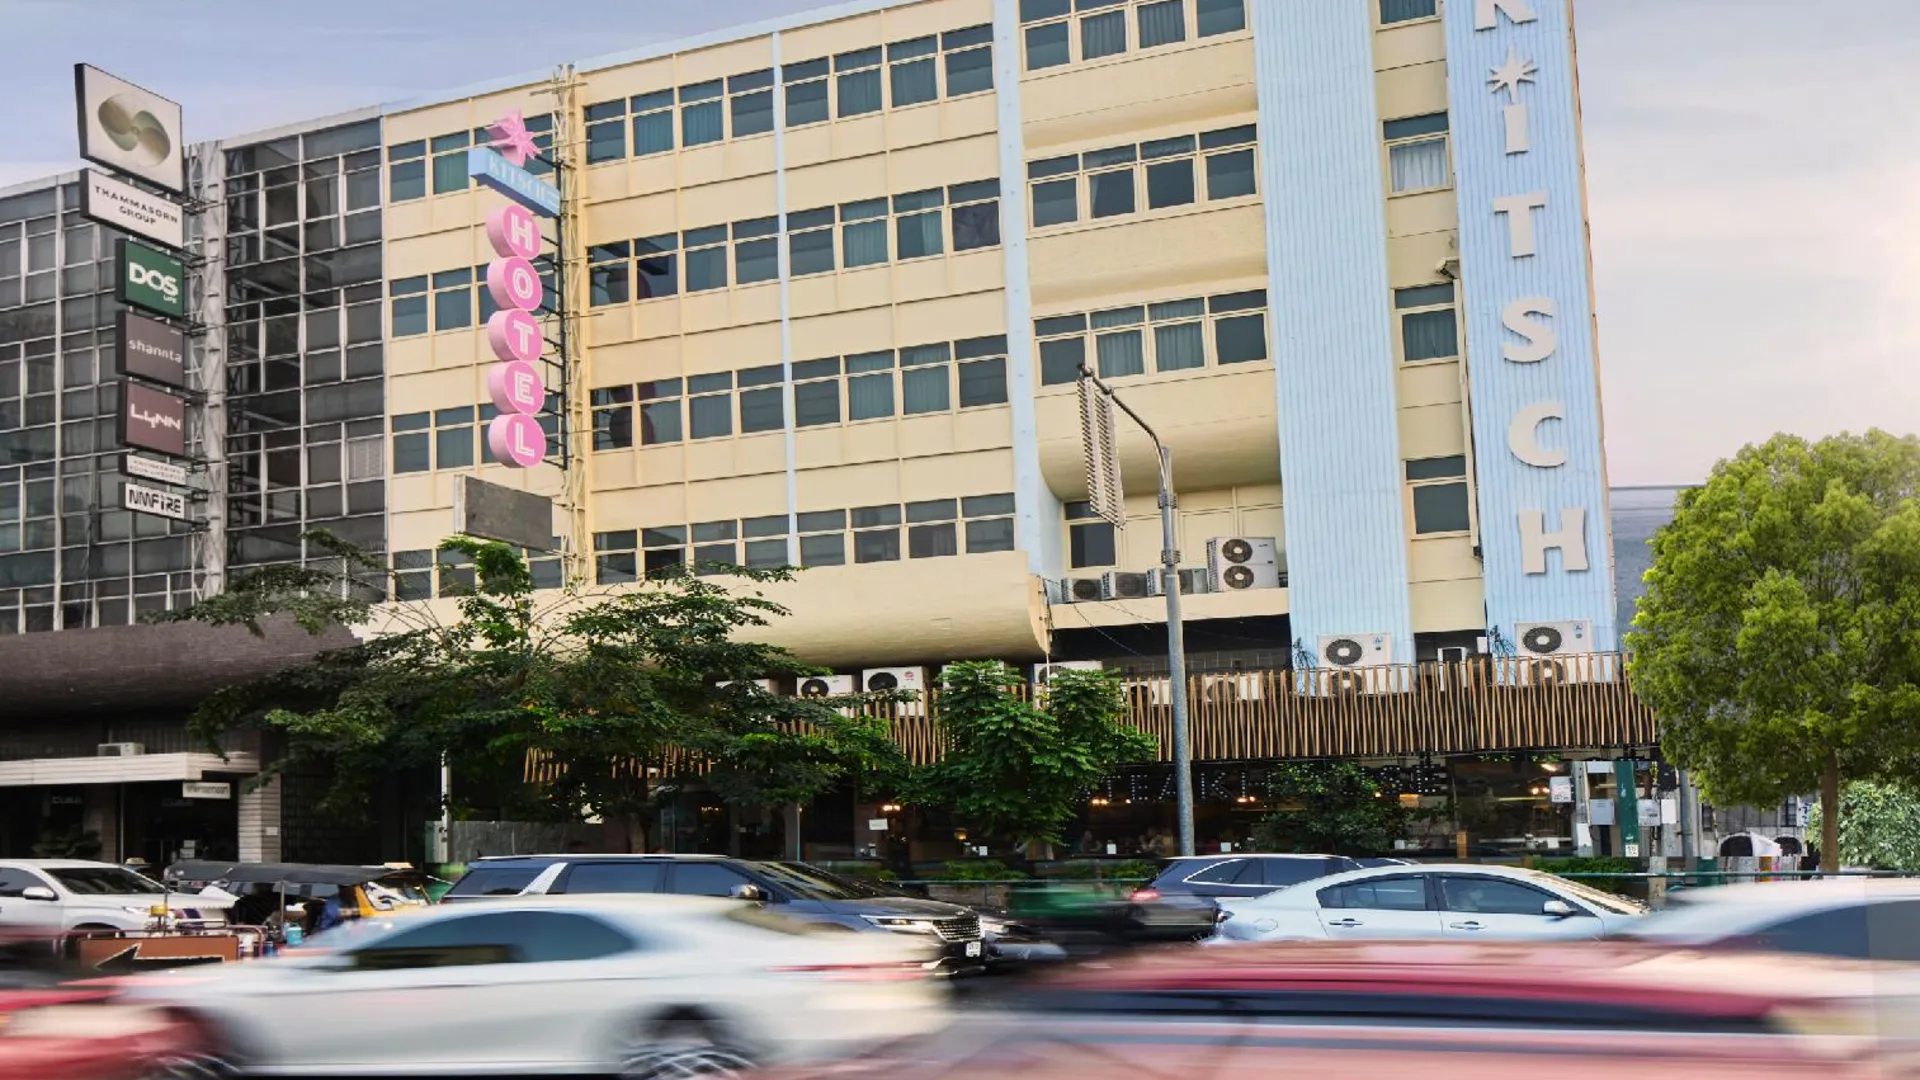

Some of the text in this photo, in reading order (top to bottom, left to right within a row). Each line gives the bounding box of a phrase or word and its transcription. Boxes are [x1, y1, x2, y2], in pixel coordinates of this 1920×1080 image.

[94, 184, 179, 224] THAMMASORN
[118, 204, 157, 226] GROUP
[128, 261, 179, 297] DOS
[128, 339, 183, 364] shannta
[510, 213, 535, 459] HOTEL
